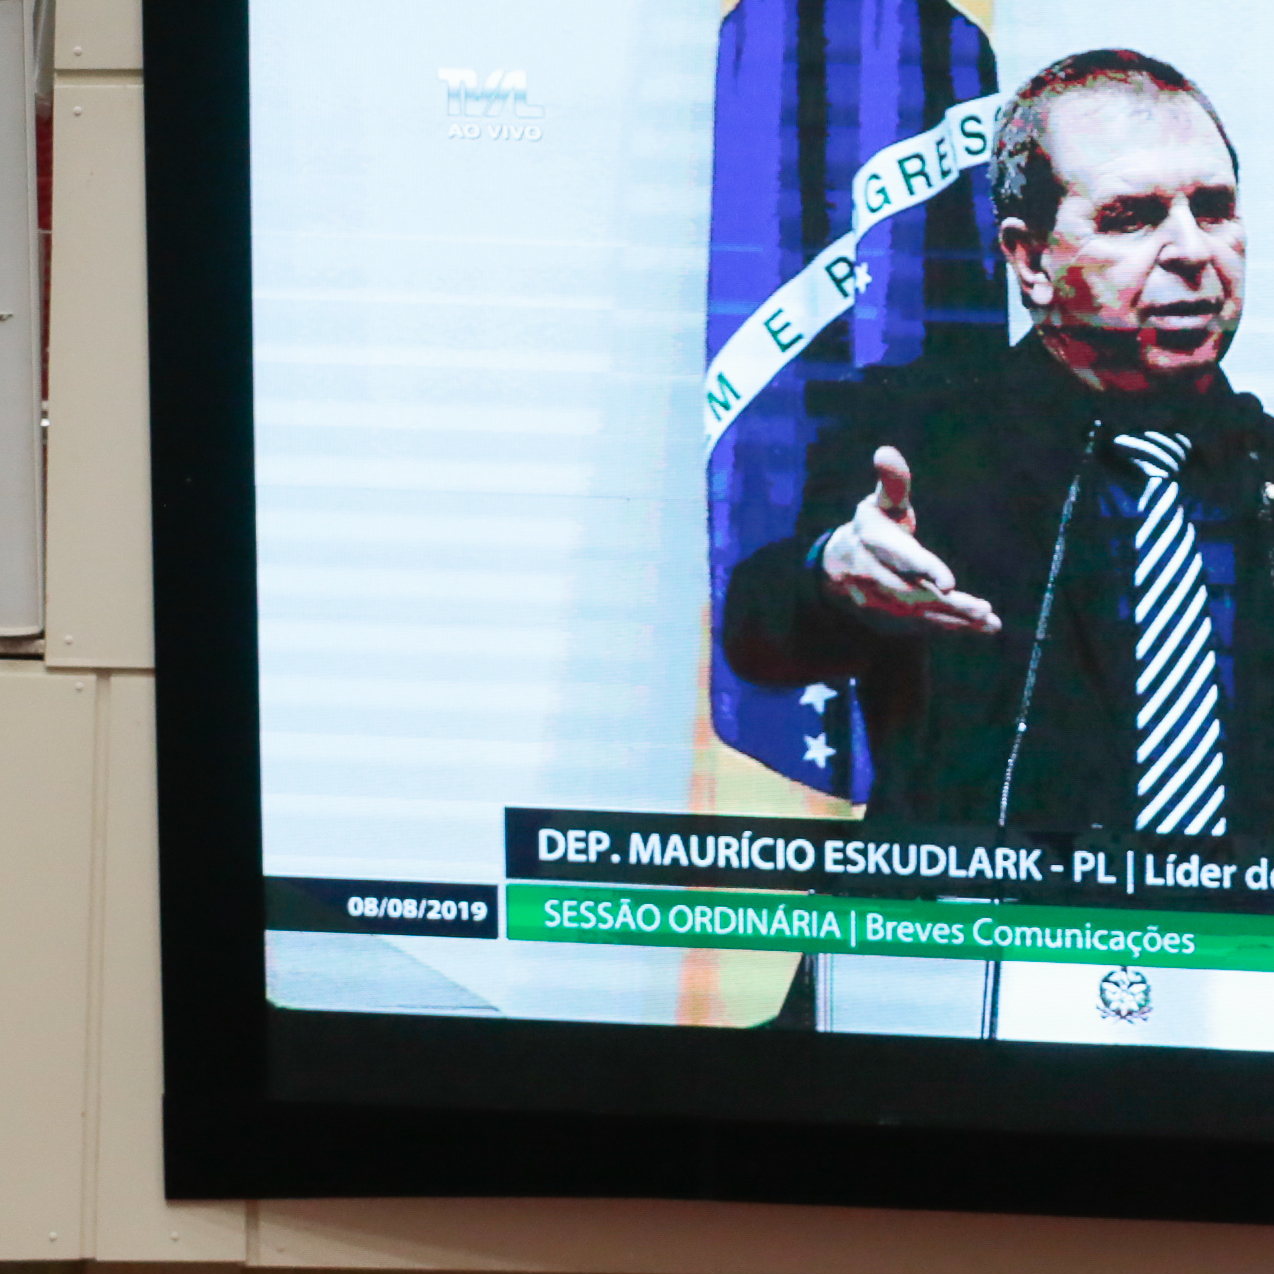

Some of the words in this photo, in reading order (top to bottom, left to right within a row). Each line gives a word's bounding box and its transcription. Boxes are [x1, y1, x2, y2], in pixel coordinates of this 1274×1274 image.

[448, 122, 482, 140] AO
[487, 124, 544, 143] VIVO
[538, 827, 621, 864] DEP.
[628, 826, 817, 873] MAURÍCIO
[823, 842, 1043, 881] ESKUDLARK
[1073, 850, 1118, 886] PL
[1145, 852, 1239, 890] Líder
[346, 896, 490, 924] 08/08/2019
[543, 897, 661, 932] SESSÃO
[668, 900, 842, 940] ORDINÁRIA
[865, 916, 965, 945] Breves
[972, 918, 1196, 958] Comunicações
